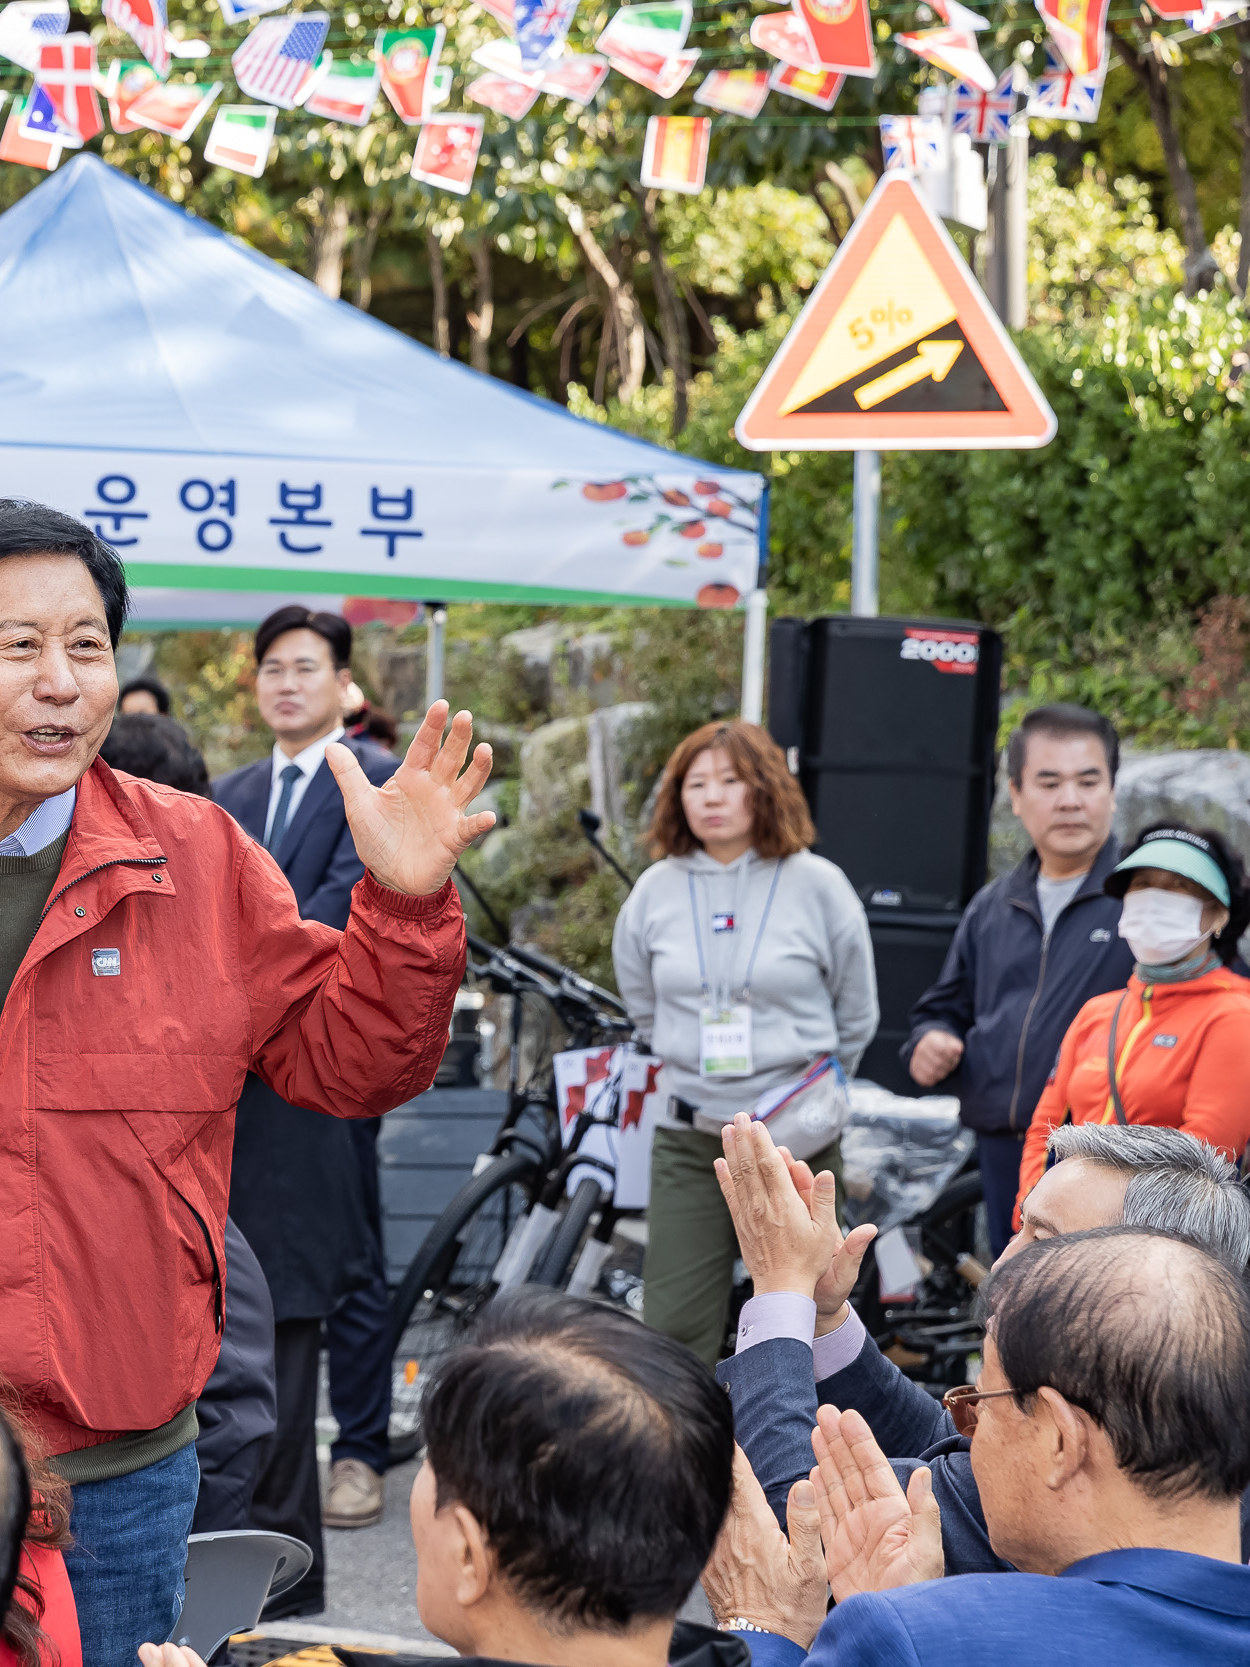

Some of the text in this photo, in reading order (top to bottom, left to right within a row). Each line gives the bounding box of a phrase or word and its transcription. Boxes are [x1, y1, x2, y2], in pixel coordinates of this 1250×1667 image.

[848, 297, 913, 351] 5%
[84, 475, 423, 557] 운영본부
[96, 957, 117, 967] CNN
